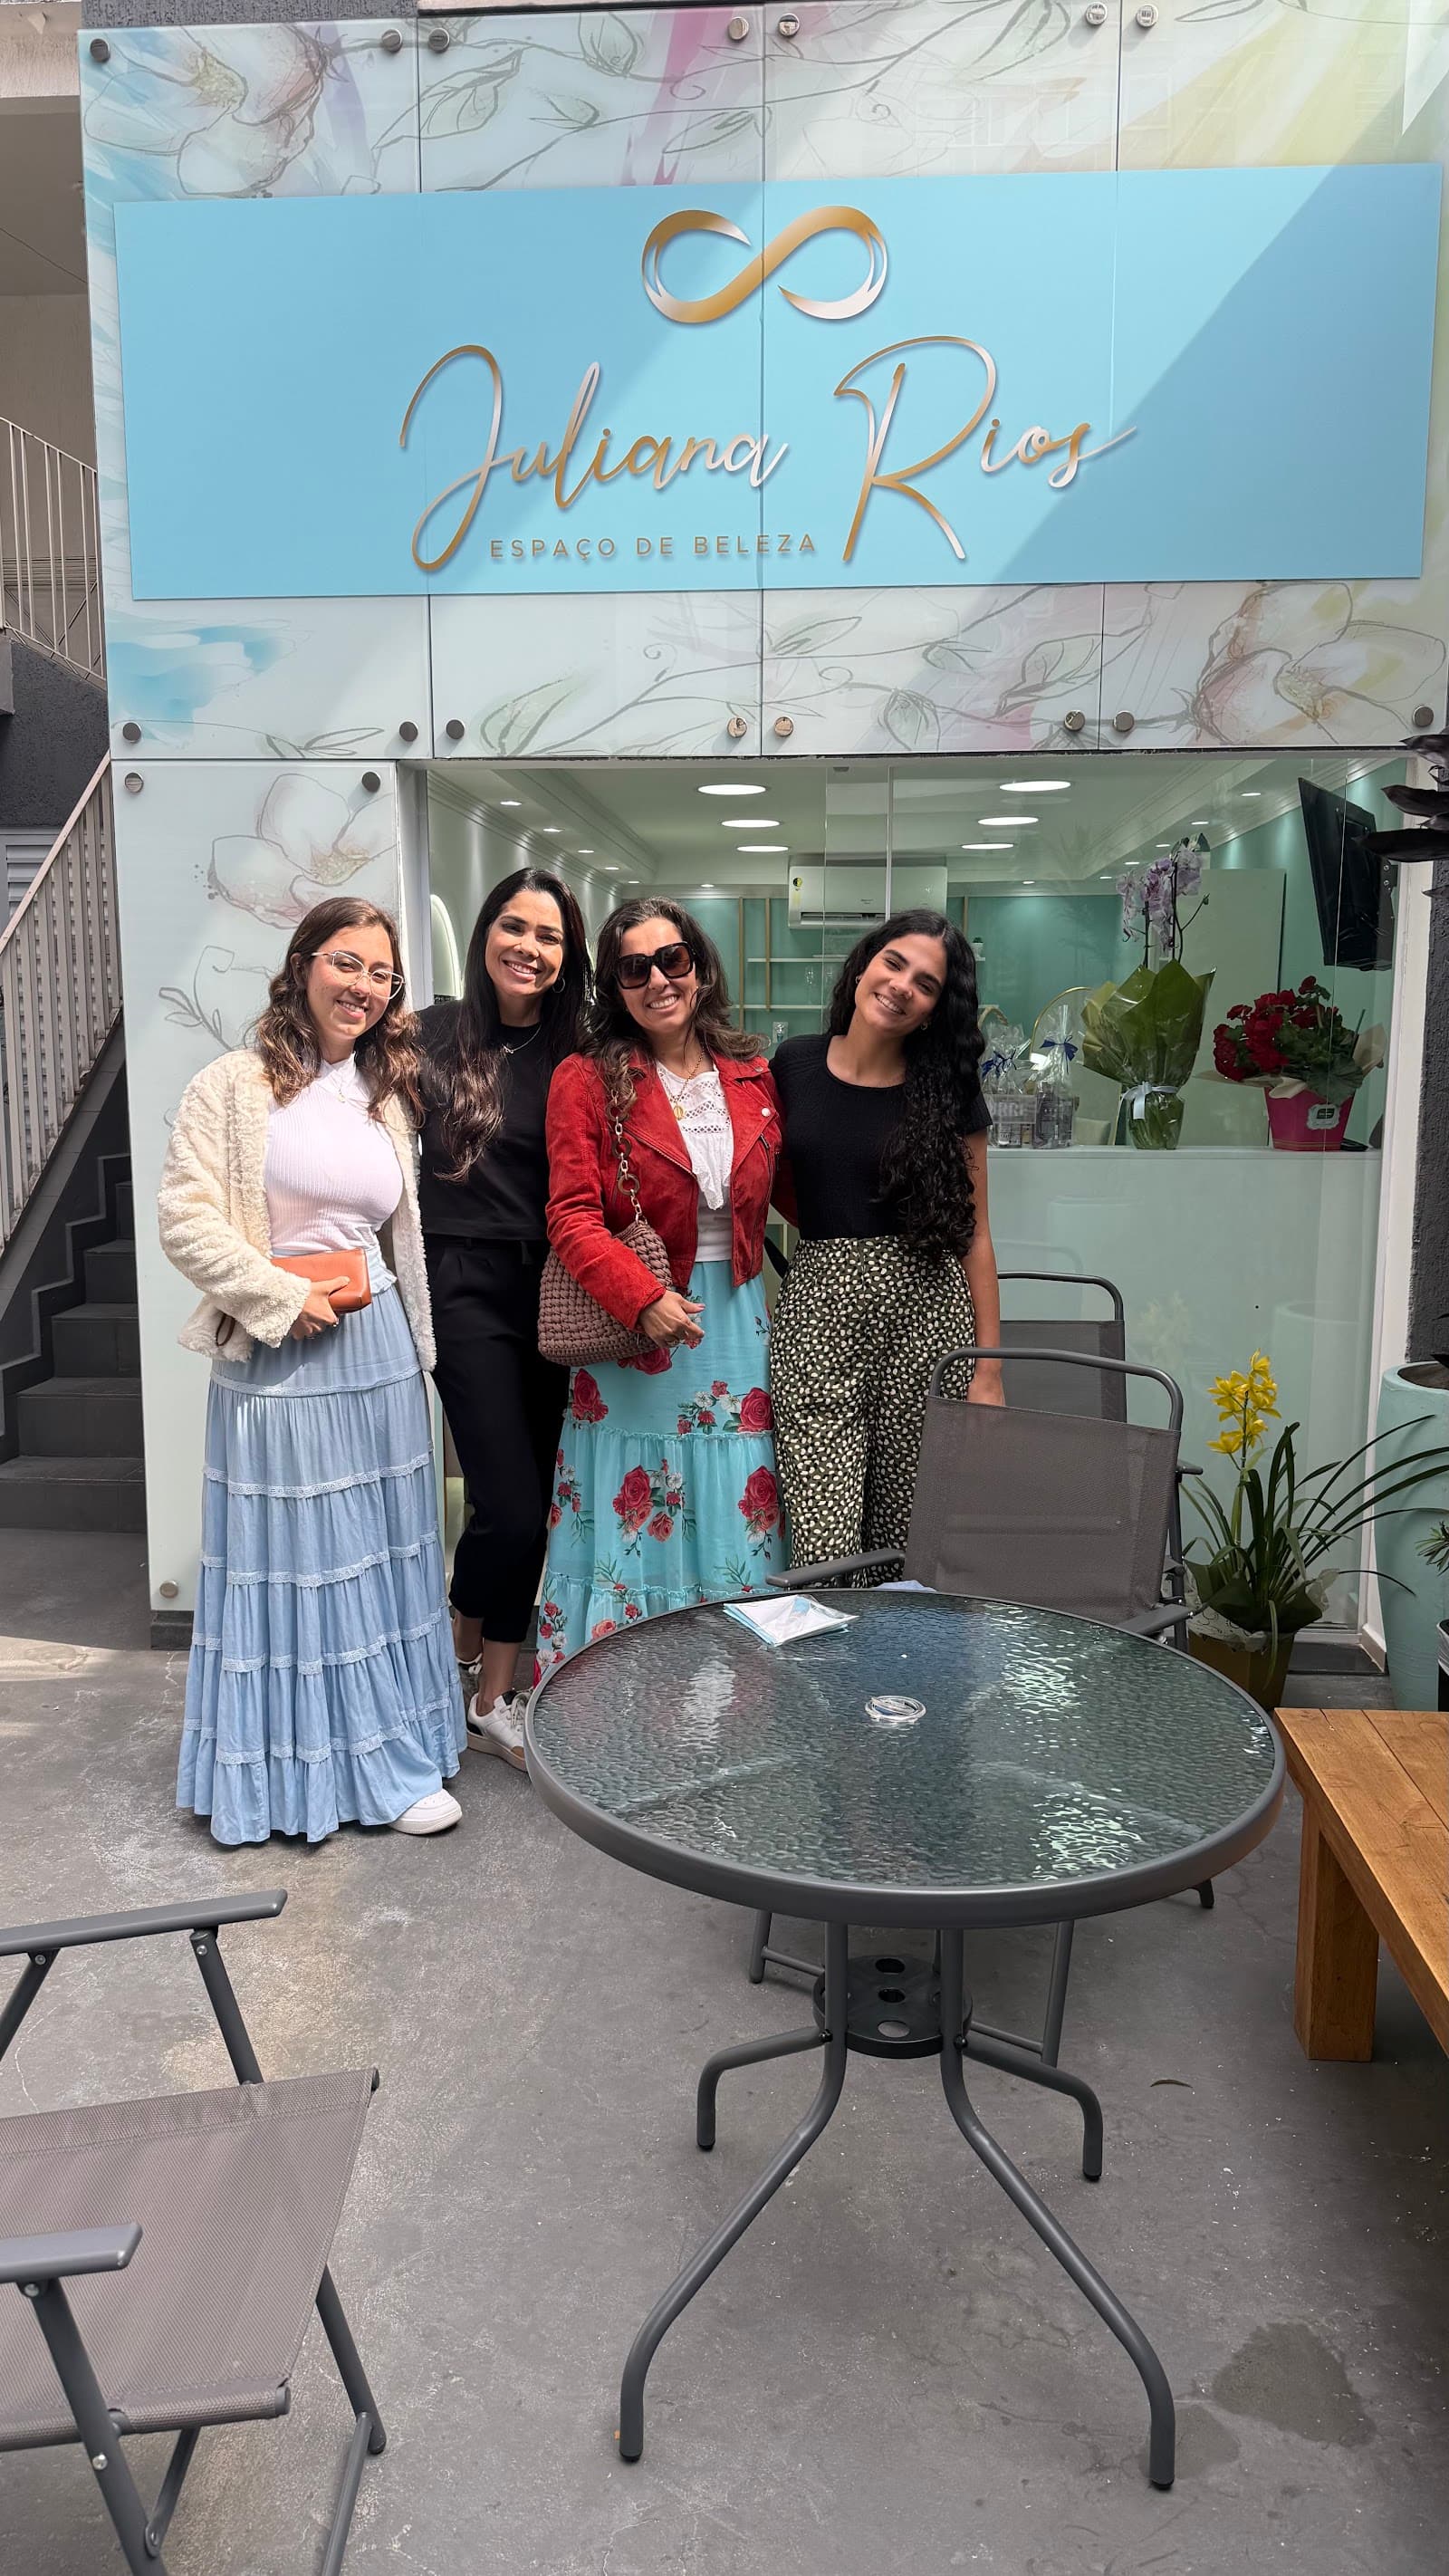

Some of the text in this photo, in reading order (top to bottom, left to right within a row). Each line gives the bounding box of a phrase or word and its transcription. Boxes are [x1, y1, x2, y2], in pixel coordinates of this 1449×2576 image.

[399, 335, 1137, 572] Juliana Rios
[490, 533, 816, 560] ESPAÇO DE BELEZA
